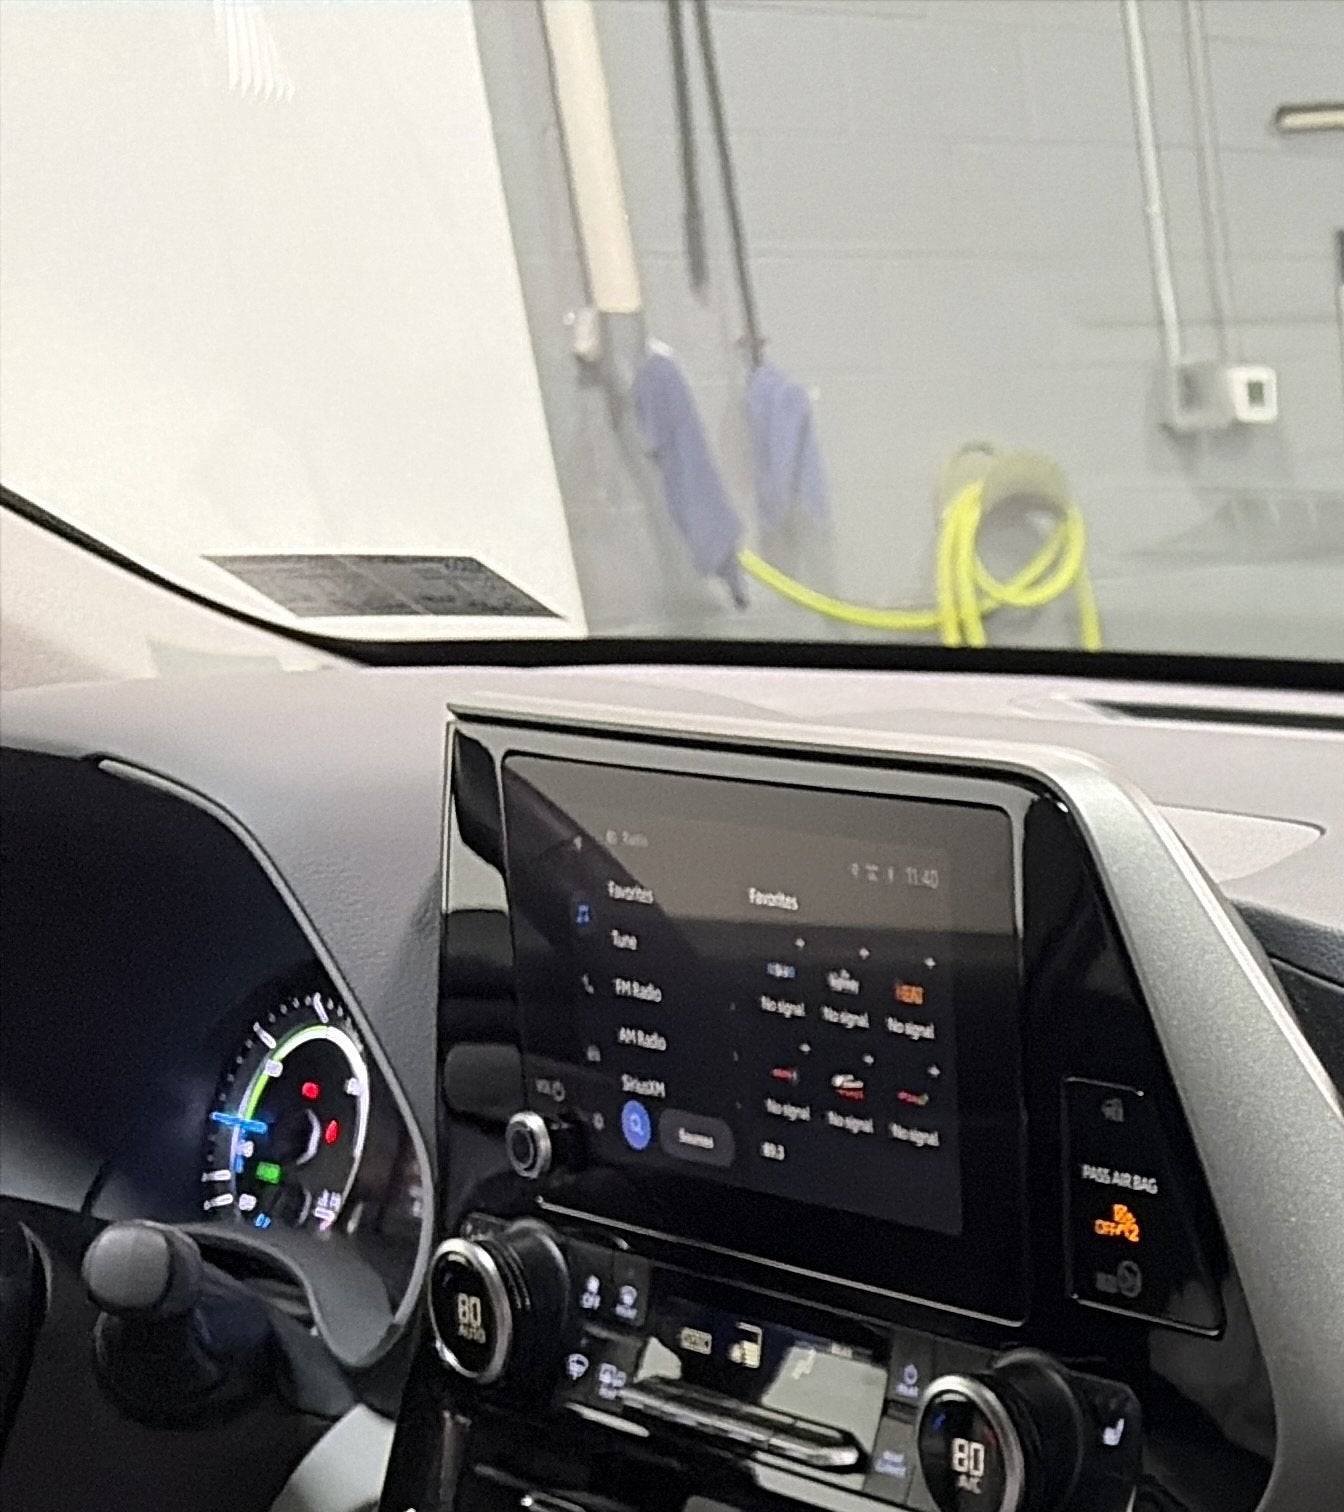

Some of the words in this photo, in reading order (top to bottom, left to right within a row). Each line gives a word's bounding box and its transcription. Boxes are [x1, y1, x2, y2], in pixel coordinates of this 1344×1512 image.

[905, 866, 940, 889] 11:40
[607, 880, 654, 904] Favorites
[749, 887, 798, 911] Favorites
[611, 929, 637, 950] Tune
[613, 977, 632, 996] FM
[632, 980, 662, 1001] Radio
[760, 995, 776, 1012] No
[777, 999, 806, 1019] signal
[821, 1006, 838, 1023] No
[839, 1010, 870, 1029] signal
[618, 1026, 637, 1045] AM
[637, 1028, 667, 1051] Radio
[885, 1016, 904, 1033] No
[904, 1021, 935, 1041] signal
[621, 1073, 666, 1098] SiriusXM
[764, 1098, 782, 1115] No
[782, 1103, 811, 1121] signal
[826, 1110, 843, 1127] No
[844, 1115, 874, 1134] signal
[888, 1122, 908, 1140] No
[908, 1128, 940, 1147] signal
[1081, 1163, 1111, 1185] PASS
[1112, 1169, 1132, 1188] AIR
[1132, 1173, 1158, 1195] BAG
[457, 1292, 482, 1328] 80
[457, 1325, 486, 1345] AUTO
[953, 1437, 985, 1477] 80
